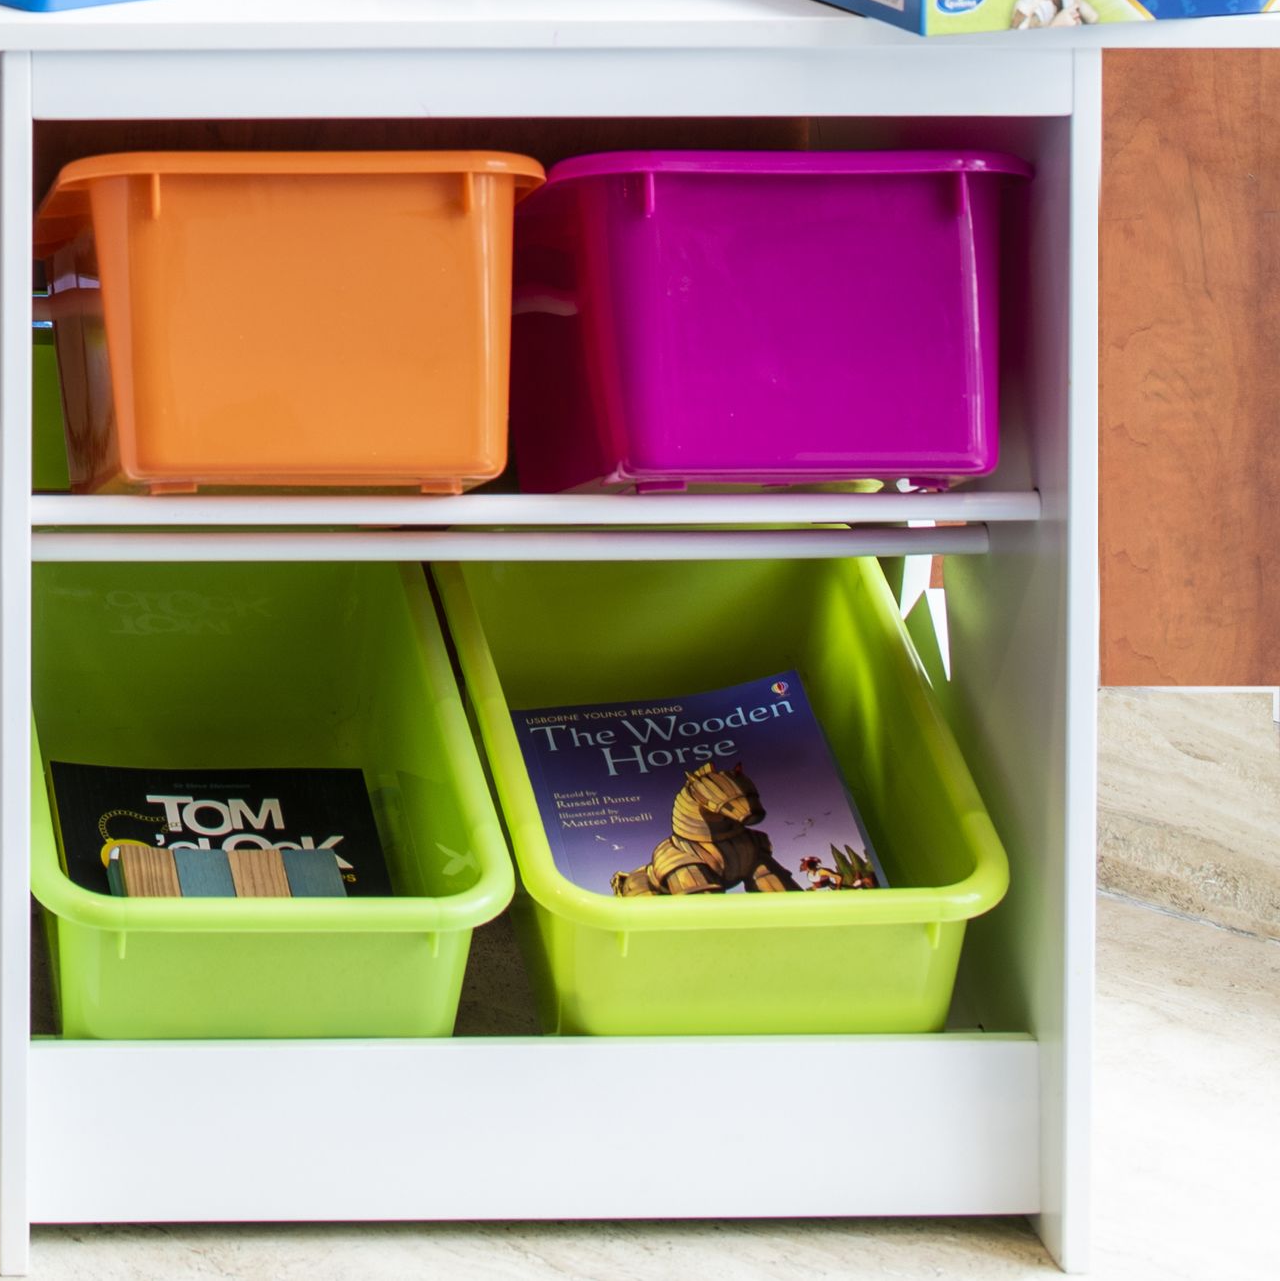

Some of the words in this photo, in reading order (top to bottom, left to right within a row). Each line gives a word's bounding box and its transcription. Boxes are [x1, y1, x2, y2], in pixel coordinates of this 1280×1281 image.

[526, 712, 578, 725] USBORNE
[584, 708, 627, 719] YOUNG
[632, 705, 683, 716] READING
[530, 725, 617, 752] The
[621, 700, 794, 744] Wooden
[600, 739, 738, 776] Horse
[554, 791, 583, 799] Retold
[585, 790, 597, 798] by
[556, 798, 599, 809] Russell
[146, 795, 285, 836] TOM
[559, 809, 606, 819] Illustrated
[562, 819, 607, 828] Matteo
[610, 812, 653, 824] Pincelli
